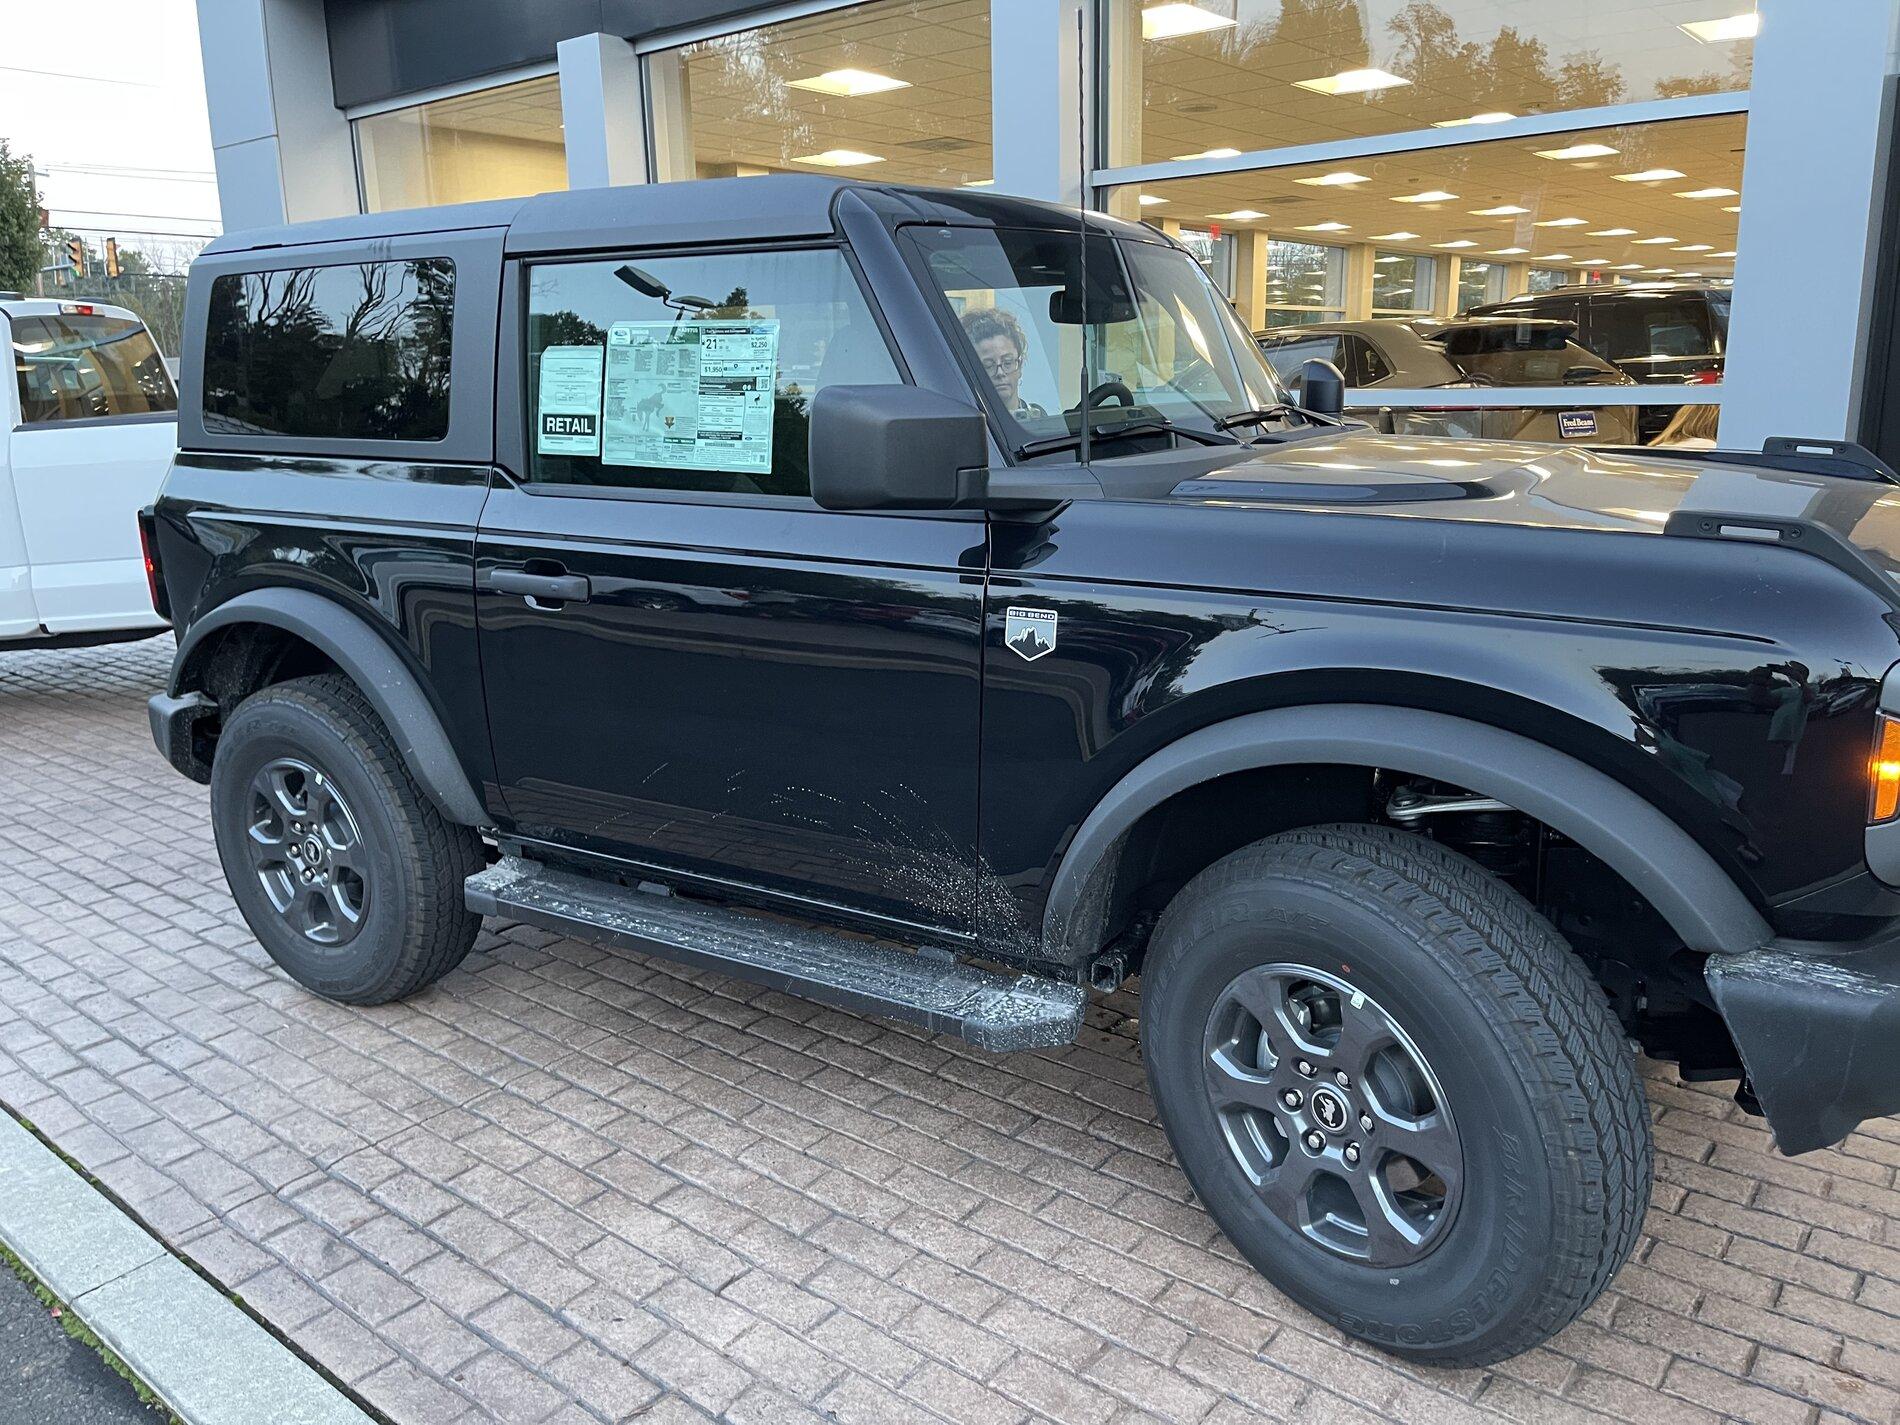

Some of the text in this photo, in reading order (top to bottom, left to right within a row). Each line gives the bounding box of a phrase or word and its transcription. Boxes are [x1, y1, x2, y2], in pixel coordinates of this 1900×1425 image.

[706, 338, 717, 350] 21
[546, 417, 592, 433] RETAIL
[1563, 418, 1576, 426] Fred
